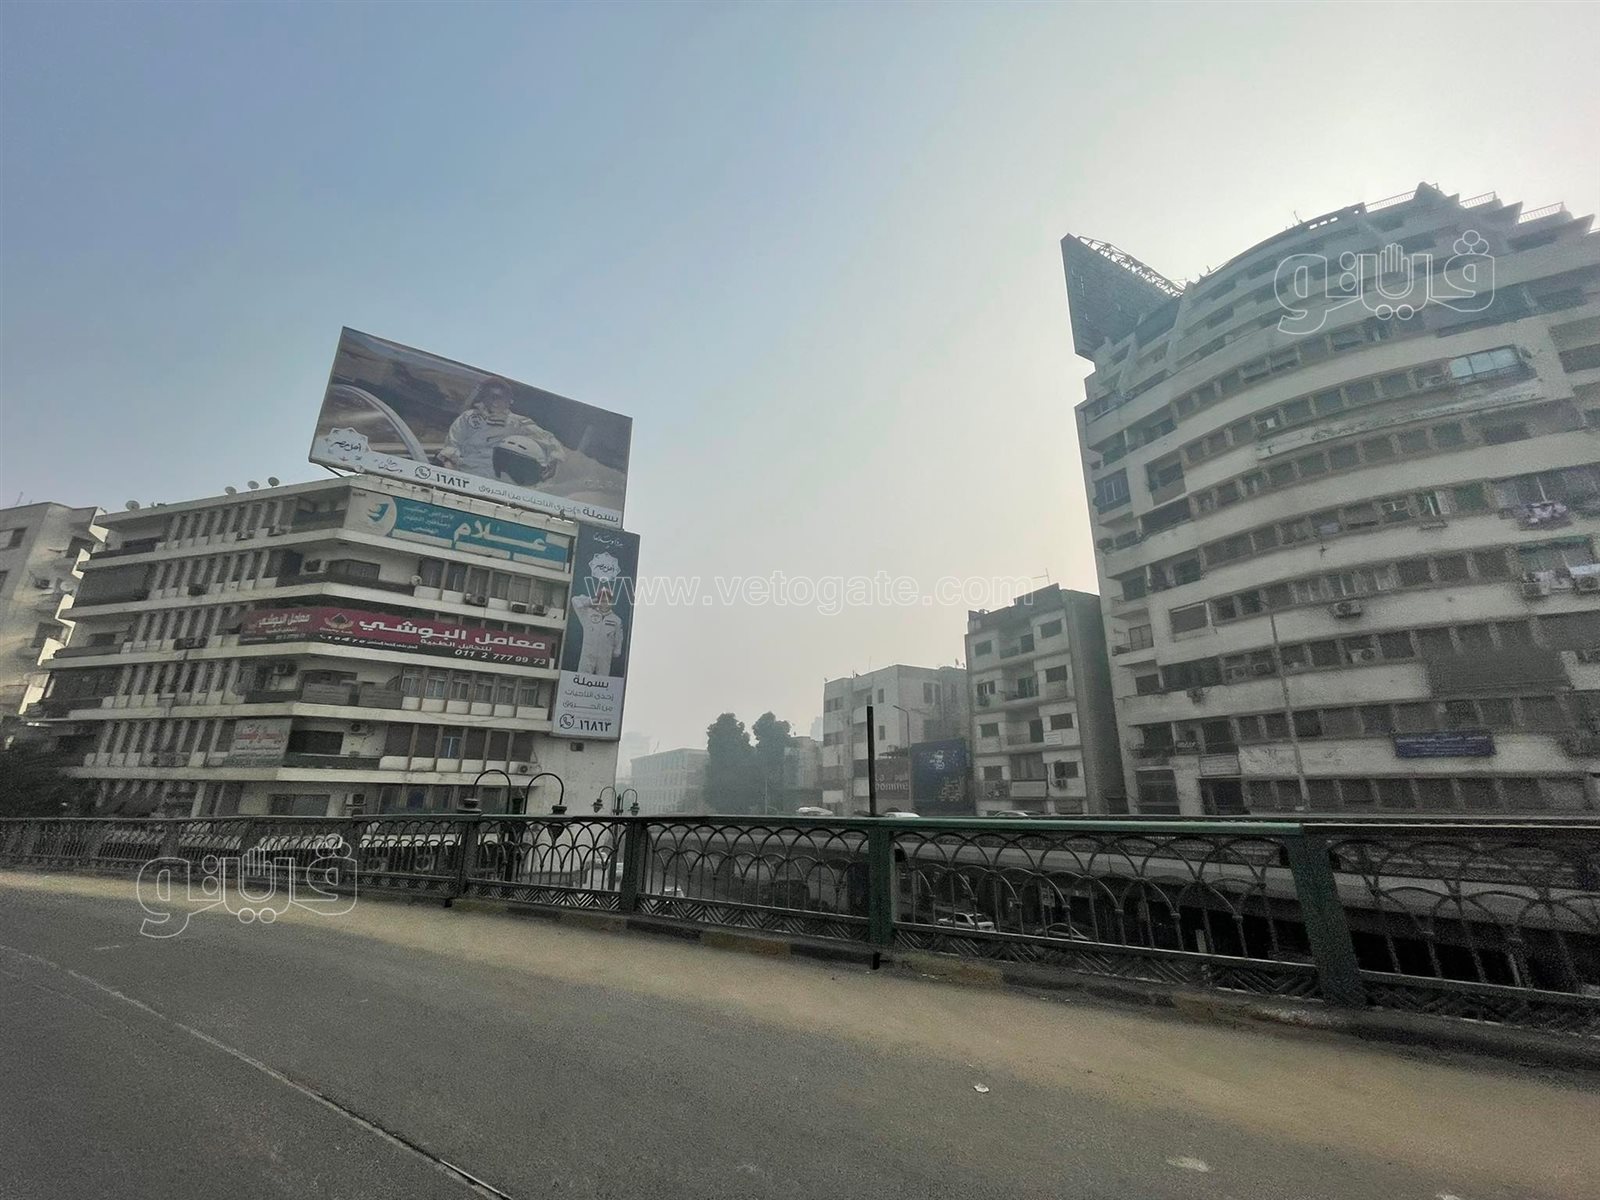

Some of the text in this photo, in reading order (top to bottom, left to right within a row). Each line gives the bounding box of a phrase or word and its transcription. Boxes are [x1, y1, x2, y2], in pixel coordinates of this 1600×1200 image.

[436, 472, 470, 488] ١٦٨٦٣
[582, 506, 619, 525] بسملة
[358, 620, 467, 641] البوشي
[420, 638, 456, 648] الطبية
[475, 632, 546, 650] معامل
[454, 649, 476, 657] 011
[481, 651, 488, 659] 2
[573, 674, 609, 691] بسملة
[580, 719, 612, 732] ١٦٨٦٣
